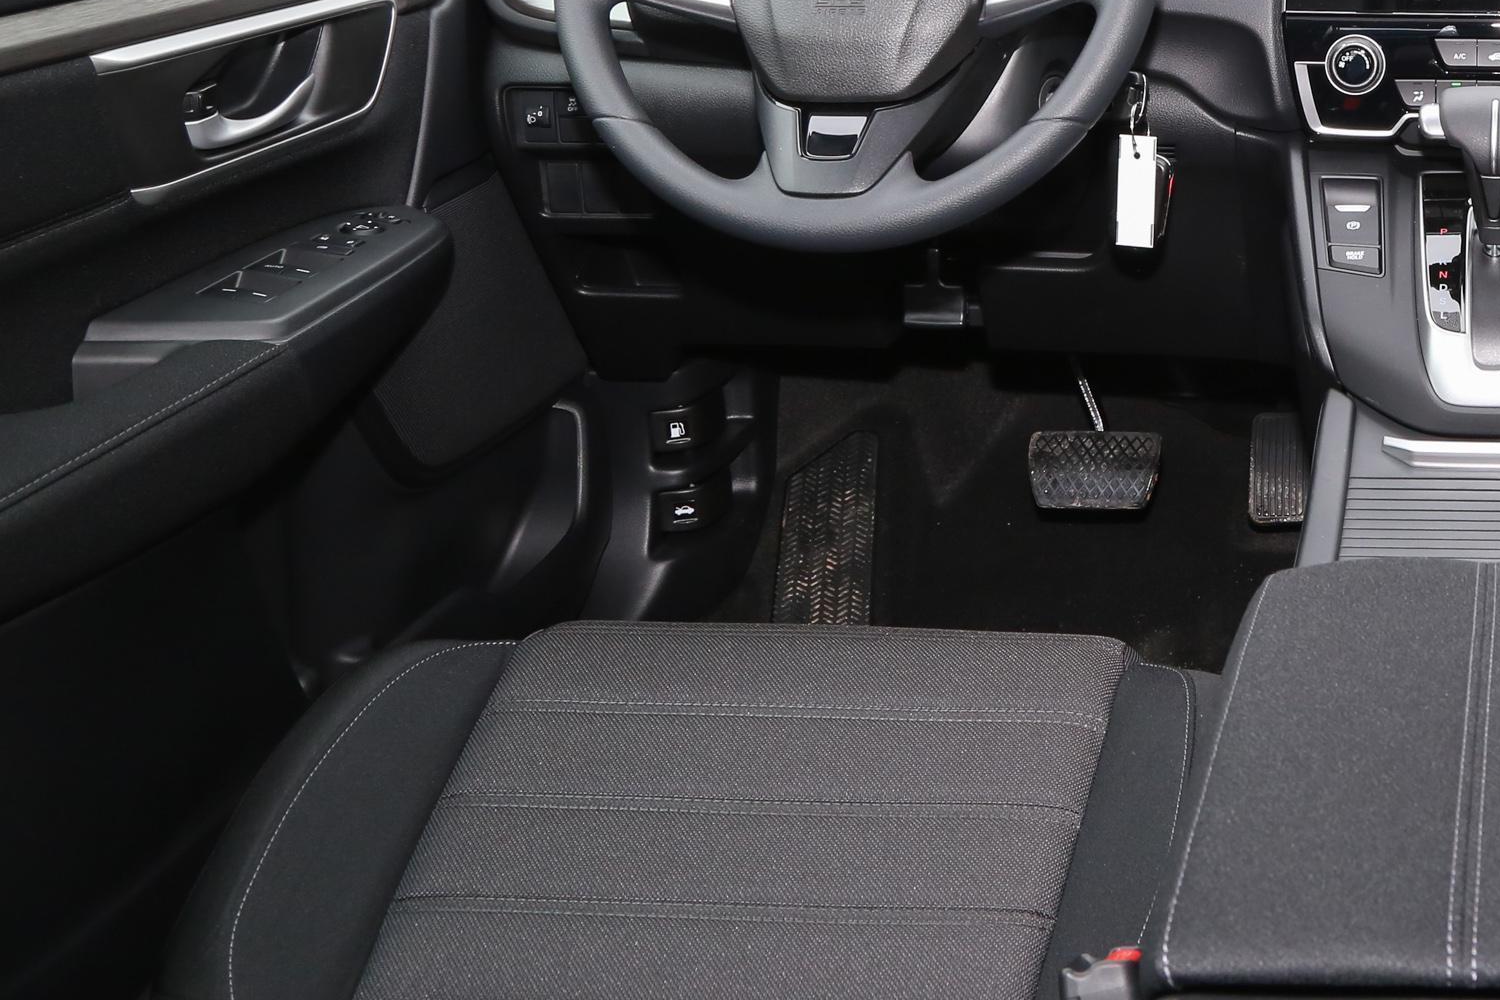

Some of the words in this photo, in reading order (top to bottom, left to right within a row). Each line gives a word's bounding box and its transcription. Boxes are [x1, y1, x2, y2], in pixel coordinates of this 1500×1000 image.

[1439, 271, 1448, 279] N
[1439, 283, 1448, 291] D
[1440, 297, 1447, 305] S
